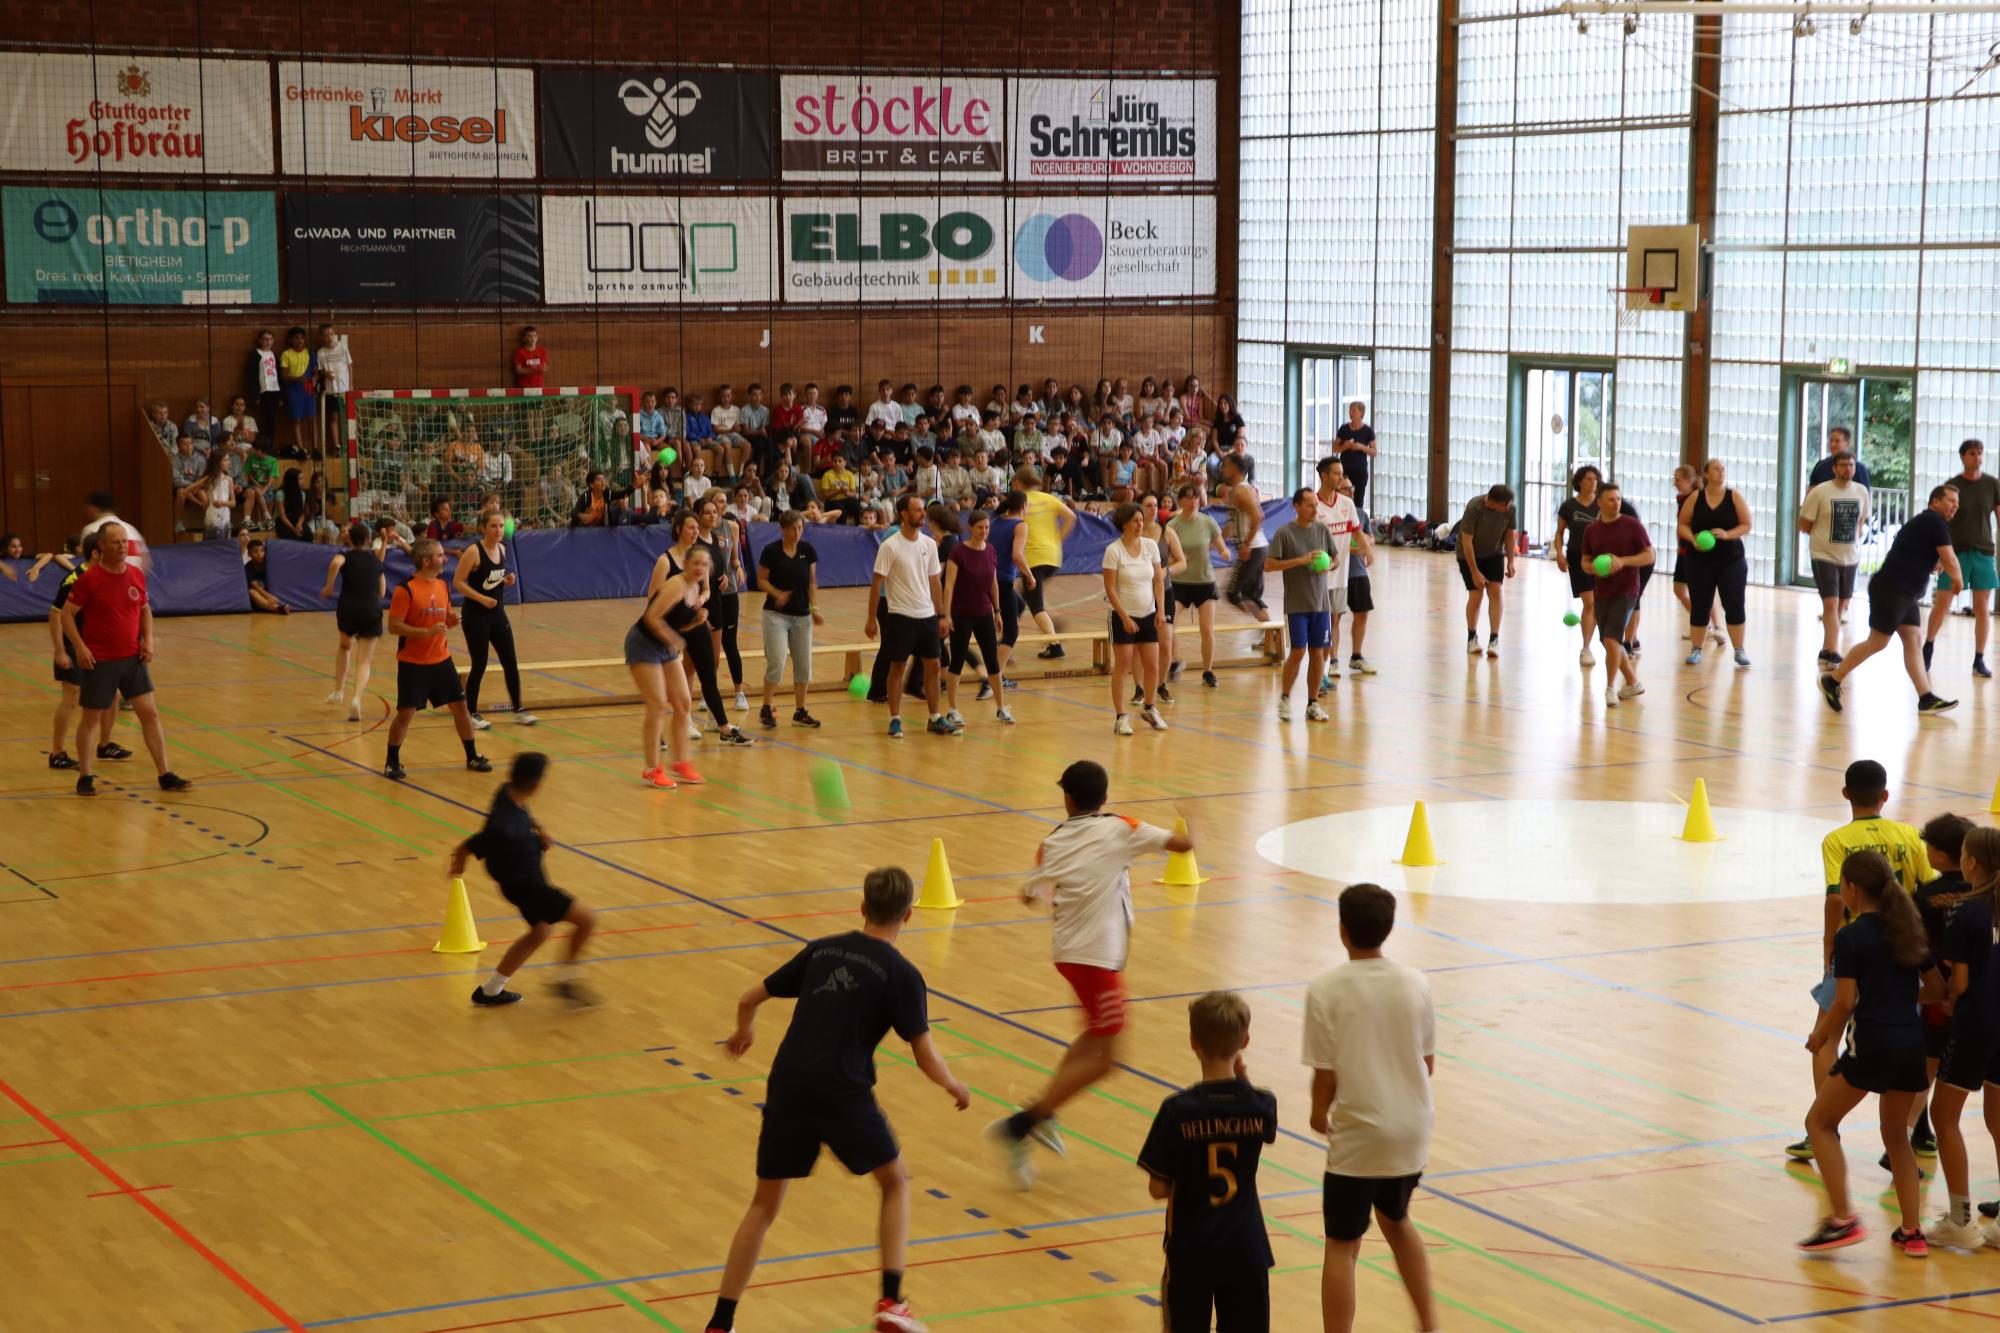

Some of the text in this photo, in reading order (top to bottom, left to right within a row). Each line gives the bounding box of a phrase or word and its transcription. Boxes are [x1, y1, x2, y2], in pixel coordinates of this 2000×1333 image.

[286, 85, 443, 105] Getränke Markt
[89, 100, 192, 125] Stuttgarter
[794, 84, 991, 136] stöckle
[1110, 94, 1159, 126] Jürg
[349, 105, 507, 144] kiesel
[65, 118, 203, 164] Hofbräu
[1030, 114, 1196, 157] Schrembs
[611, 146, 712, 174] hummel
[826, 145, 985, 165] BROT & CAFÉ
[1031, 159, 1112, 175] INGENIEURBÜRO
[1121, 160, 1194, 174] WOHNDESIGN
[86, 207, 249, 255] ortho-p
[294, 227, 456, 240] CAVADA UND PARTNER
[791, 211, 995, 262] ELBO
[1110, 219, 1159, 240] Beck
[1109, 243, 1208, 258] Steuerberatungs
[105, 255, 183, 268] BIETIGHEIM
[1109, 259, 1180, 277] gesellschaft
[36, 270, 70, 282] Dres.
[109, 270, 184, 283] Karavalakis
[196, 271, 251, 283] Sommer
[587, 282, 687, 291] barthe asmuth
[792, 271, 920, 288] Gebäudetechnik
[760, 329, 770, 347] J
[1029, 325, 1045, 344] K
[1180, 1118, 1264, 1141] BELLINGHAM
[1207, 1142, 1239, 1208] 5
